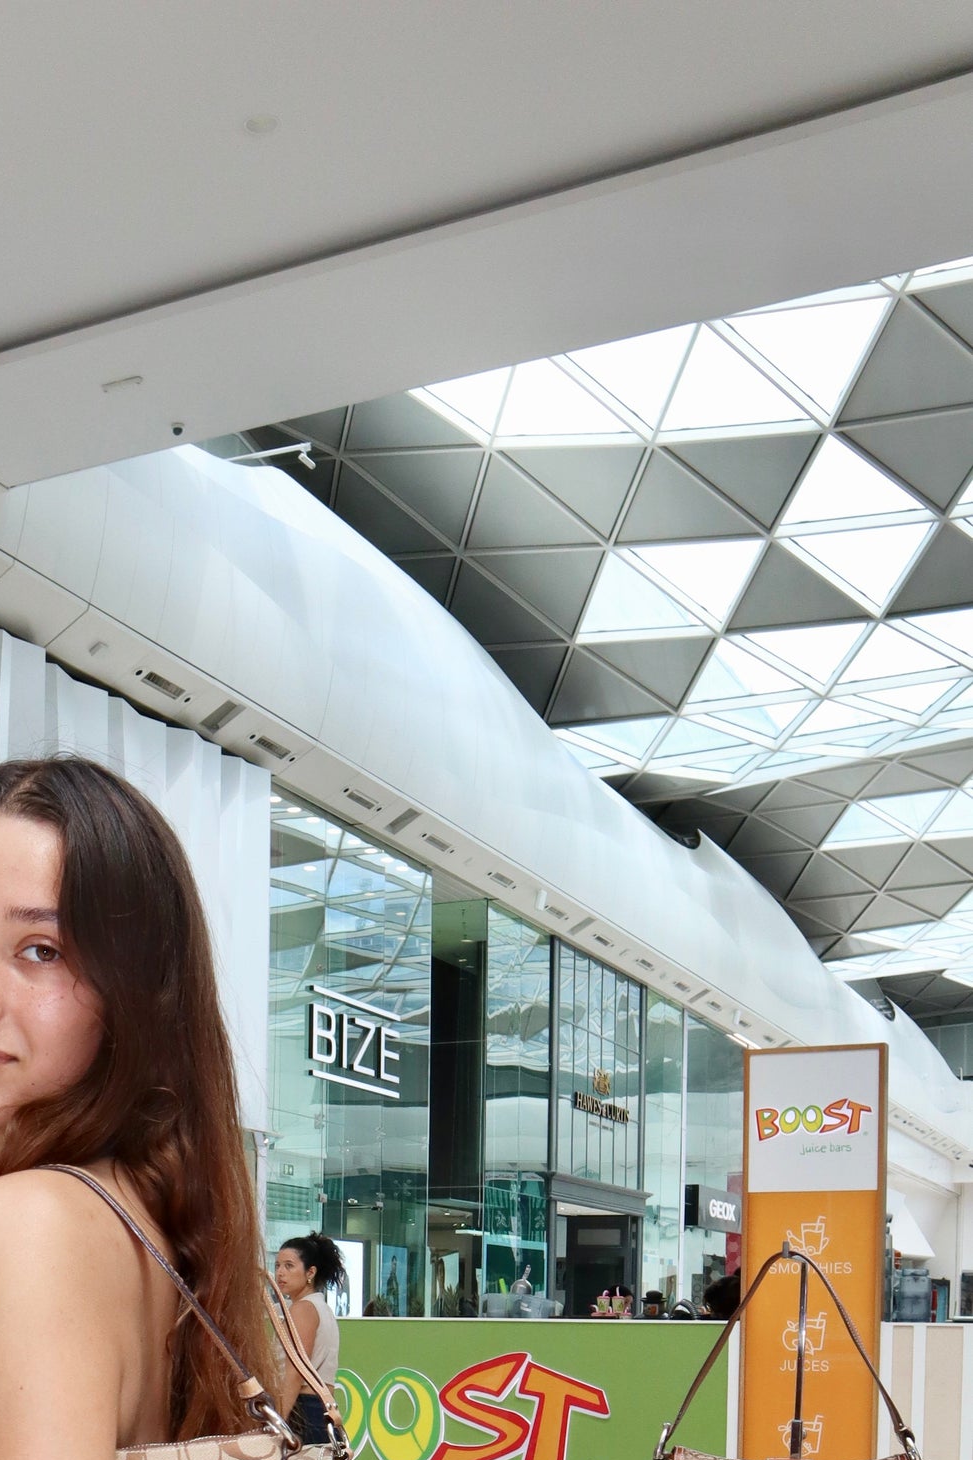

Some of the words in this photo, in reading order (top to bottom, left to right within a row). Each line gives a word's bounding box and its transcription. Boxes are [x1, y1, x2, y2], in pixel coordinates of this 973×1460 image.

[309, 1003, 400, 1084] BIZE
[575, 1091, 602, 1115] HAWES
[756, 1098, 872, 1141] BOOST
[800, 1143, 827, 1155] juice
[829, 1143, 852, 1153] bars
[709, 1199, 736, 1222] GEOX
[779, 1360, 829, 1371] JUCES
